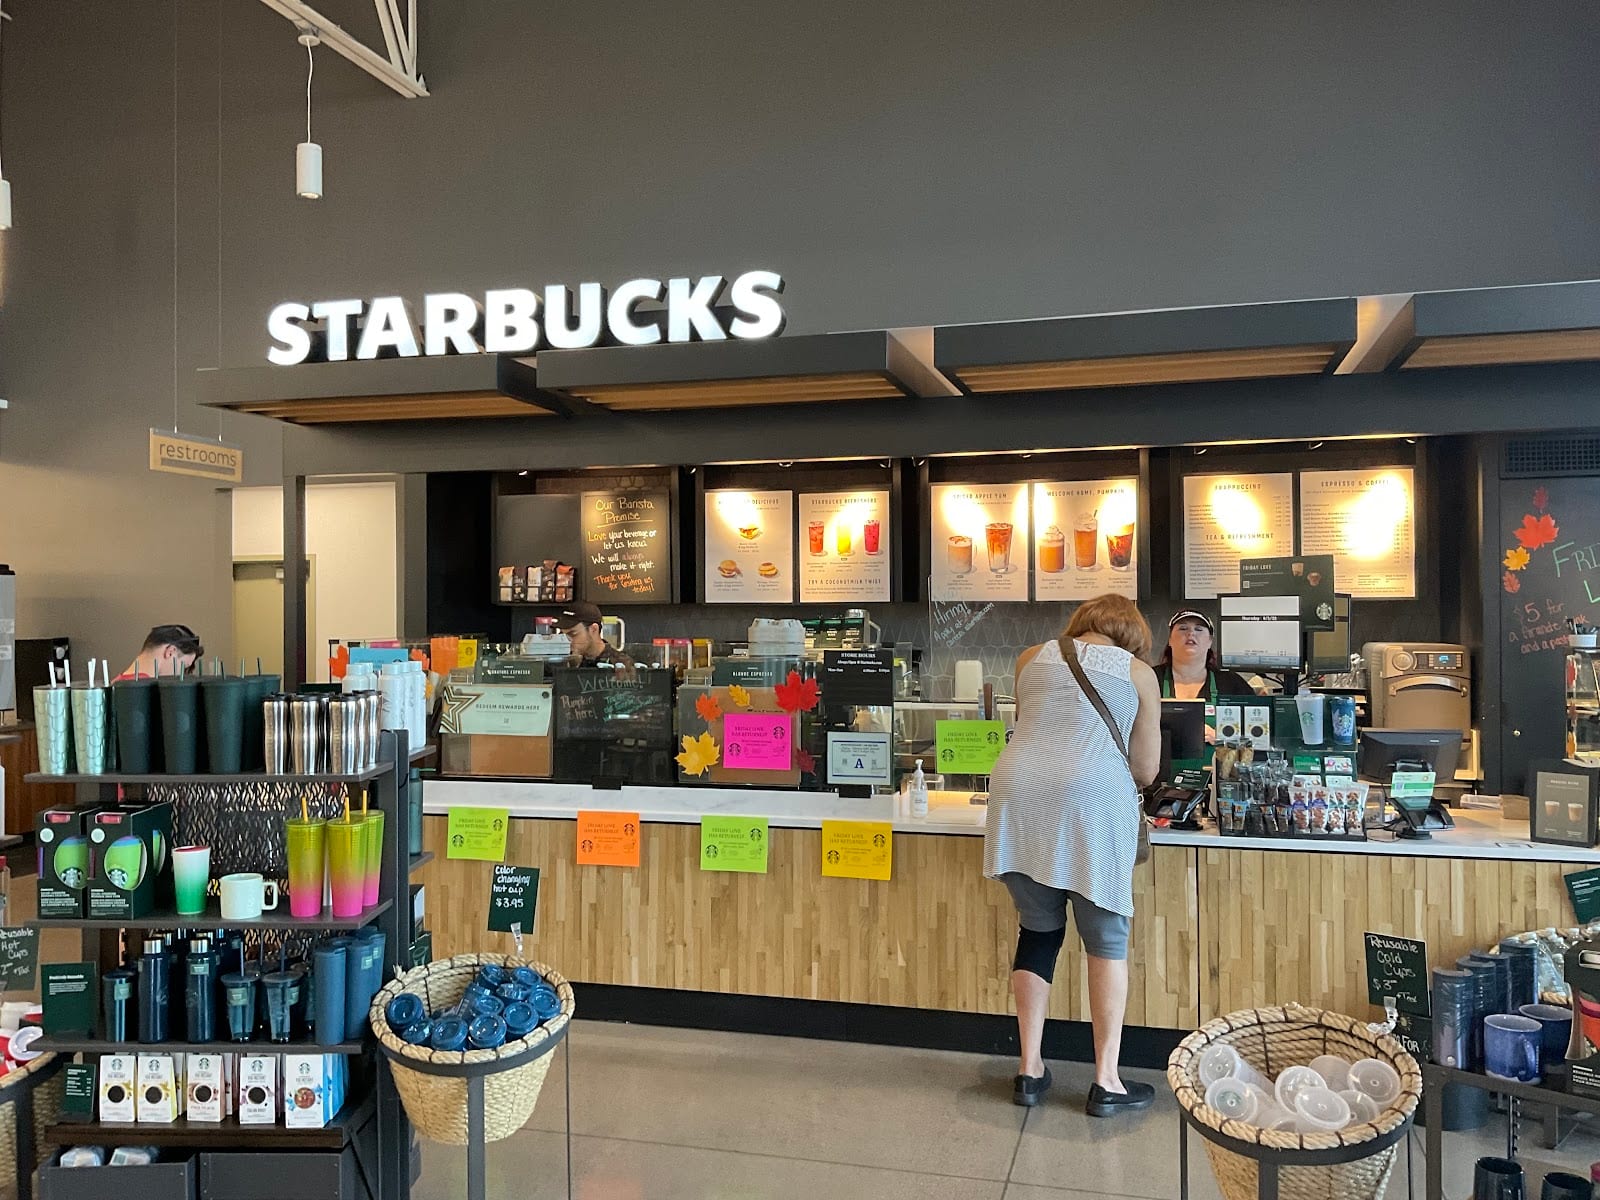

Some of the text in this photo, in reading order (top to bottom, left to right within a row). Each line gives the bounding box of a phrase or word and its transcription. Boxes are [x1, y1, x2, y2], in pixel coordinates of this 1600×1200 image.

[267, 270, 784, 366] STARBUCKS
[160, 443, 237, 467] restrooms
[595, 496, 655, 511] Our Barista
[602, 511, 641, 523] Promise
[588, 531, 606, 542] Love
[608, 530, 624, 543] your
[648, 530, 657, 538] or
[604, 541, 612, 550] let
[614, 541, 624, 549] us
[592, 552, 605, 564] We
[608, 552, 618, 562] will
[610, 562, 628, 572] make
[630, 562, 637, 570] it
[594, 572, 632, 585] Thank you
[934, 598, 972, 625] Hiring!
[1546, 598, 1564, 616] for
[1509, 631, 1519, 643] a
[1521, 640, 1540, 654] and
[1542, 640, 1550, 650] a
[577, 674, 644, 690] Welcome!
[560, 695, 593, 708] Pumpkin
[574, 708, 598, 720] here!
[854, 758, 864, 768] A
[497, 875, 530, 886] changing
[493, 884, 524, 896] hot cup
[496, 897, 524, 908] $3.95
[2, 940, 20, 952] Hot
[1366, 934, 1418, 954] Reusable
[8, 948, 28, 960] Cups
[1376, 950, 1402, 964] Cold
[1384, 964, 1416, 979] Cups
[1402, 1035, 1420, 1053] FOR
